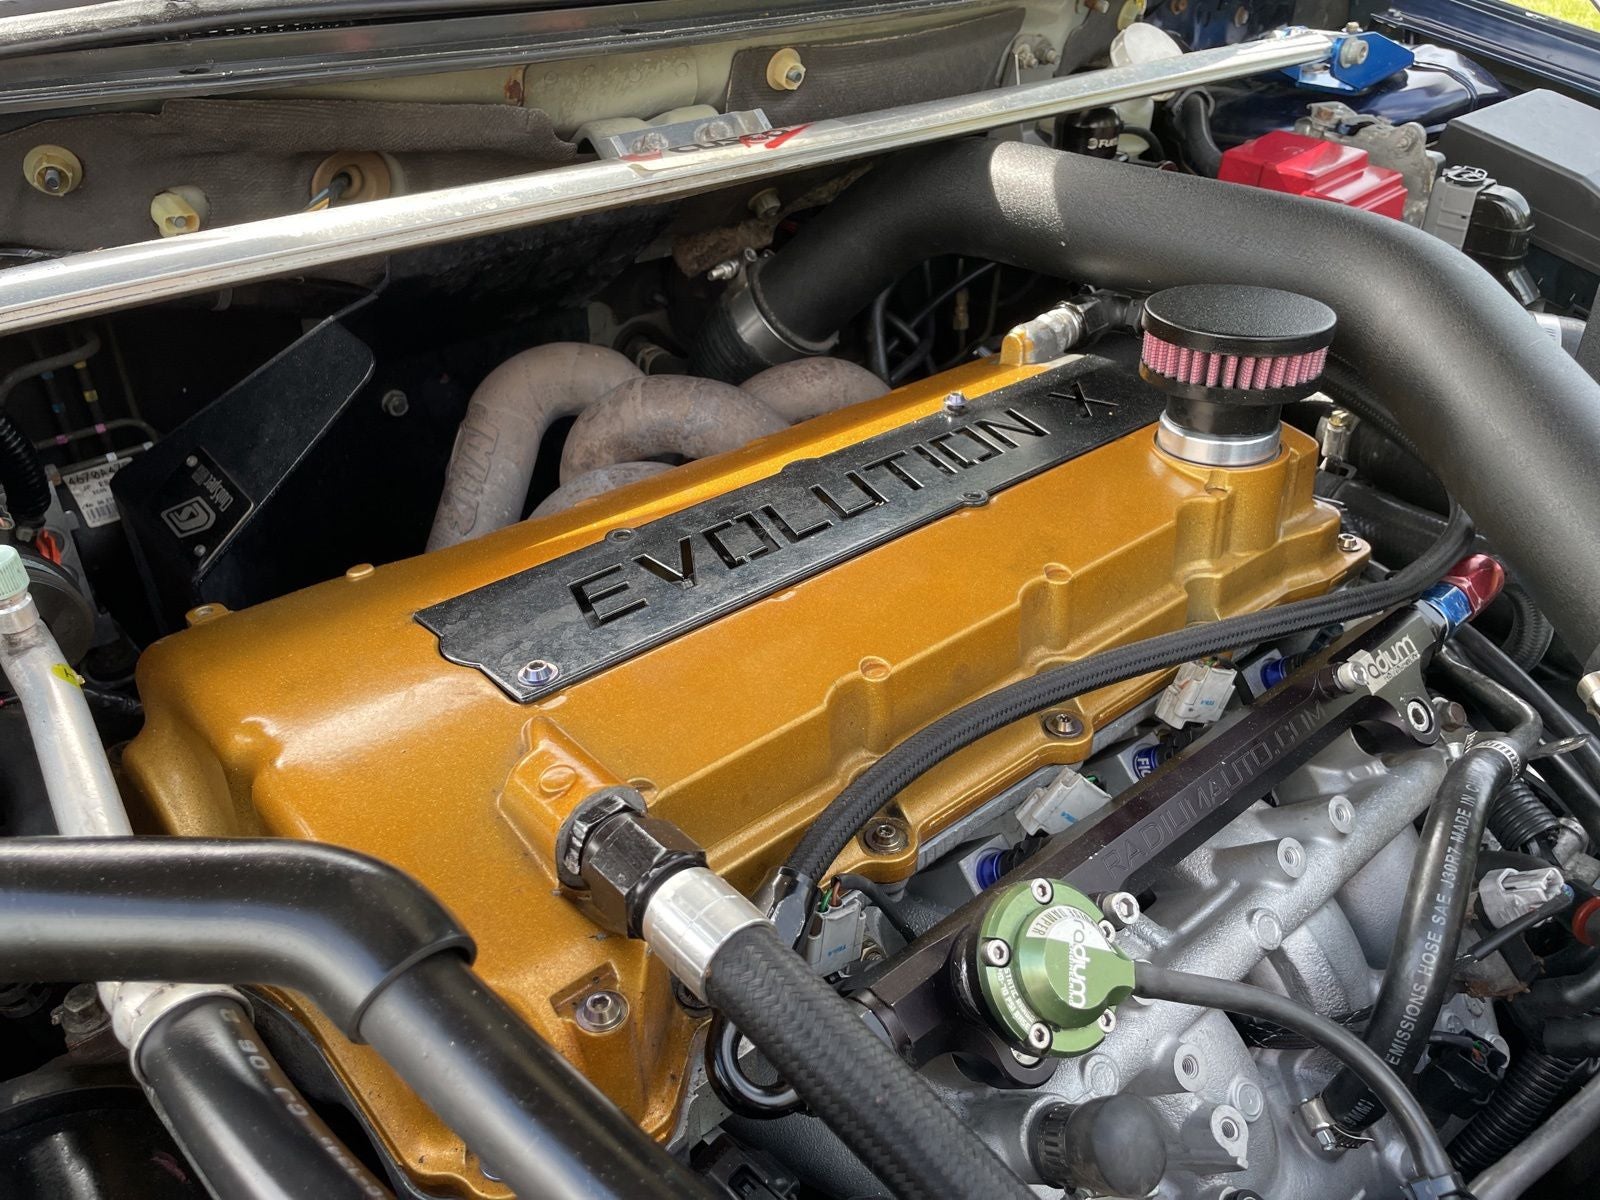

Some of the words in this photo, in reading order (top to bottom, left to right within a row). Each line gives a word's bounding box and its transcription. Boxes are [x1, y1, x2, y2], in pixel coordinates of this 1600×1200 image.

[68, 459, 127, 485] 4670A47
[568, 407, 1051, 628] EVOLUTION
[1047, 380, 1120, 419] X
[1367, 634, 1419, 679] adium
[1459, 793, 1476, 808] IN
[1450, 807, 1472, 844] MADE
[1440, 845, 1462, 889] J30R7
[1031, 907, 1066, 937] DAMPER
[1431, 893, 1453, 926] SAE
[1072, 918, 1092, 1010] radium
[1417, 930, 1443, 977] HOSE
[1004, 967, 1019, 999] STATIC
[1385, 982, 1428, 1067] EMISSIONS
